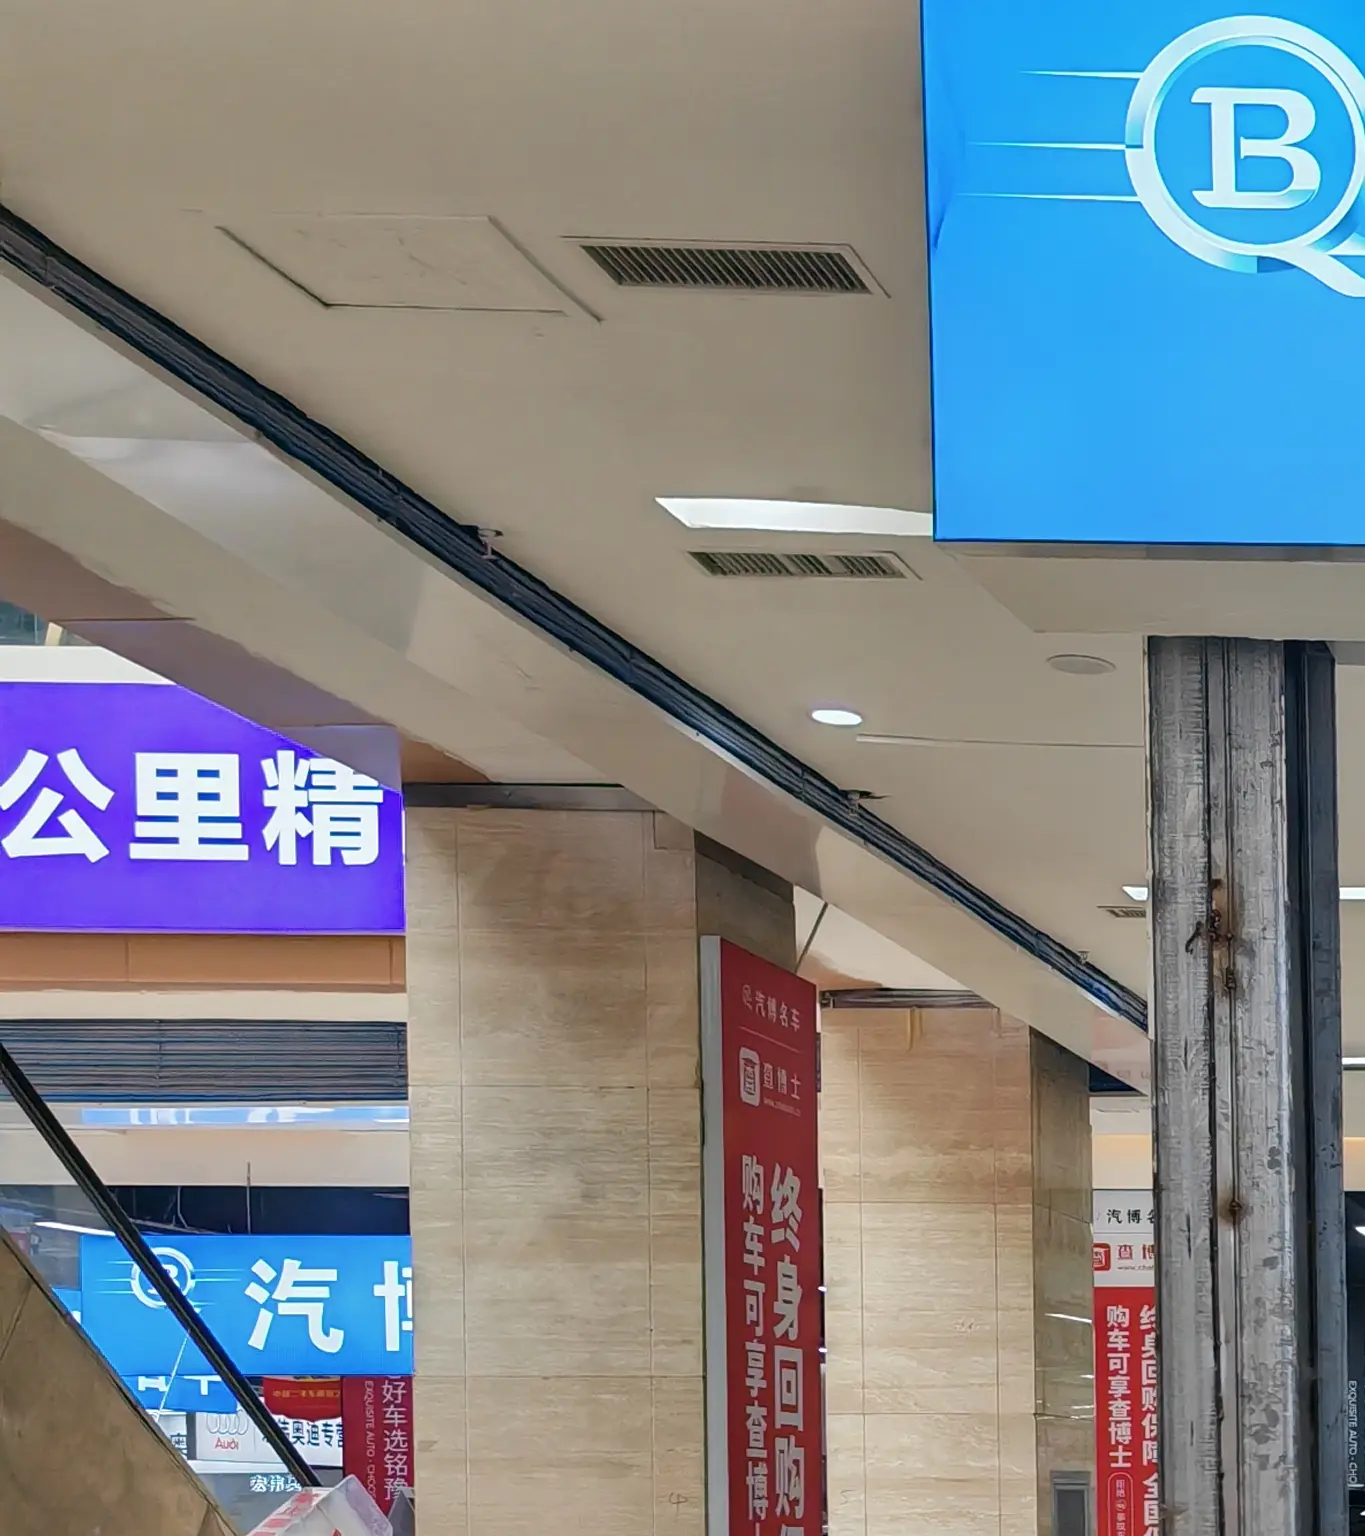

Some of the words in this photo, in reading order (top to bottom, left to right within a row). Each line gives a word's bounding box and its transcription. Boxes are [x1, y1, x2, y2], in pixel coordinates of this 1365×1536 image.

[0, 748, 384, 866] 公里精
[755, 990, 801, 1032] 汽博名车
[364, 1381, 375, 1430] EXQUISITE
[1106, 1305, 1133, 1468] 购车可享查博士
[1348, 1380, 1358, 1428] EXQUISITE
[214, 1437, 240, 1451] Audi
[366, 1431, 375, 1458] AUTO
[1348, 1430, 1358, 1456] AUTO
